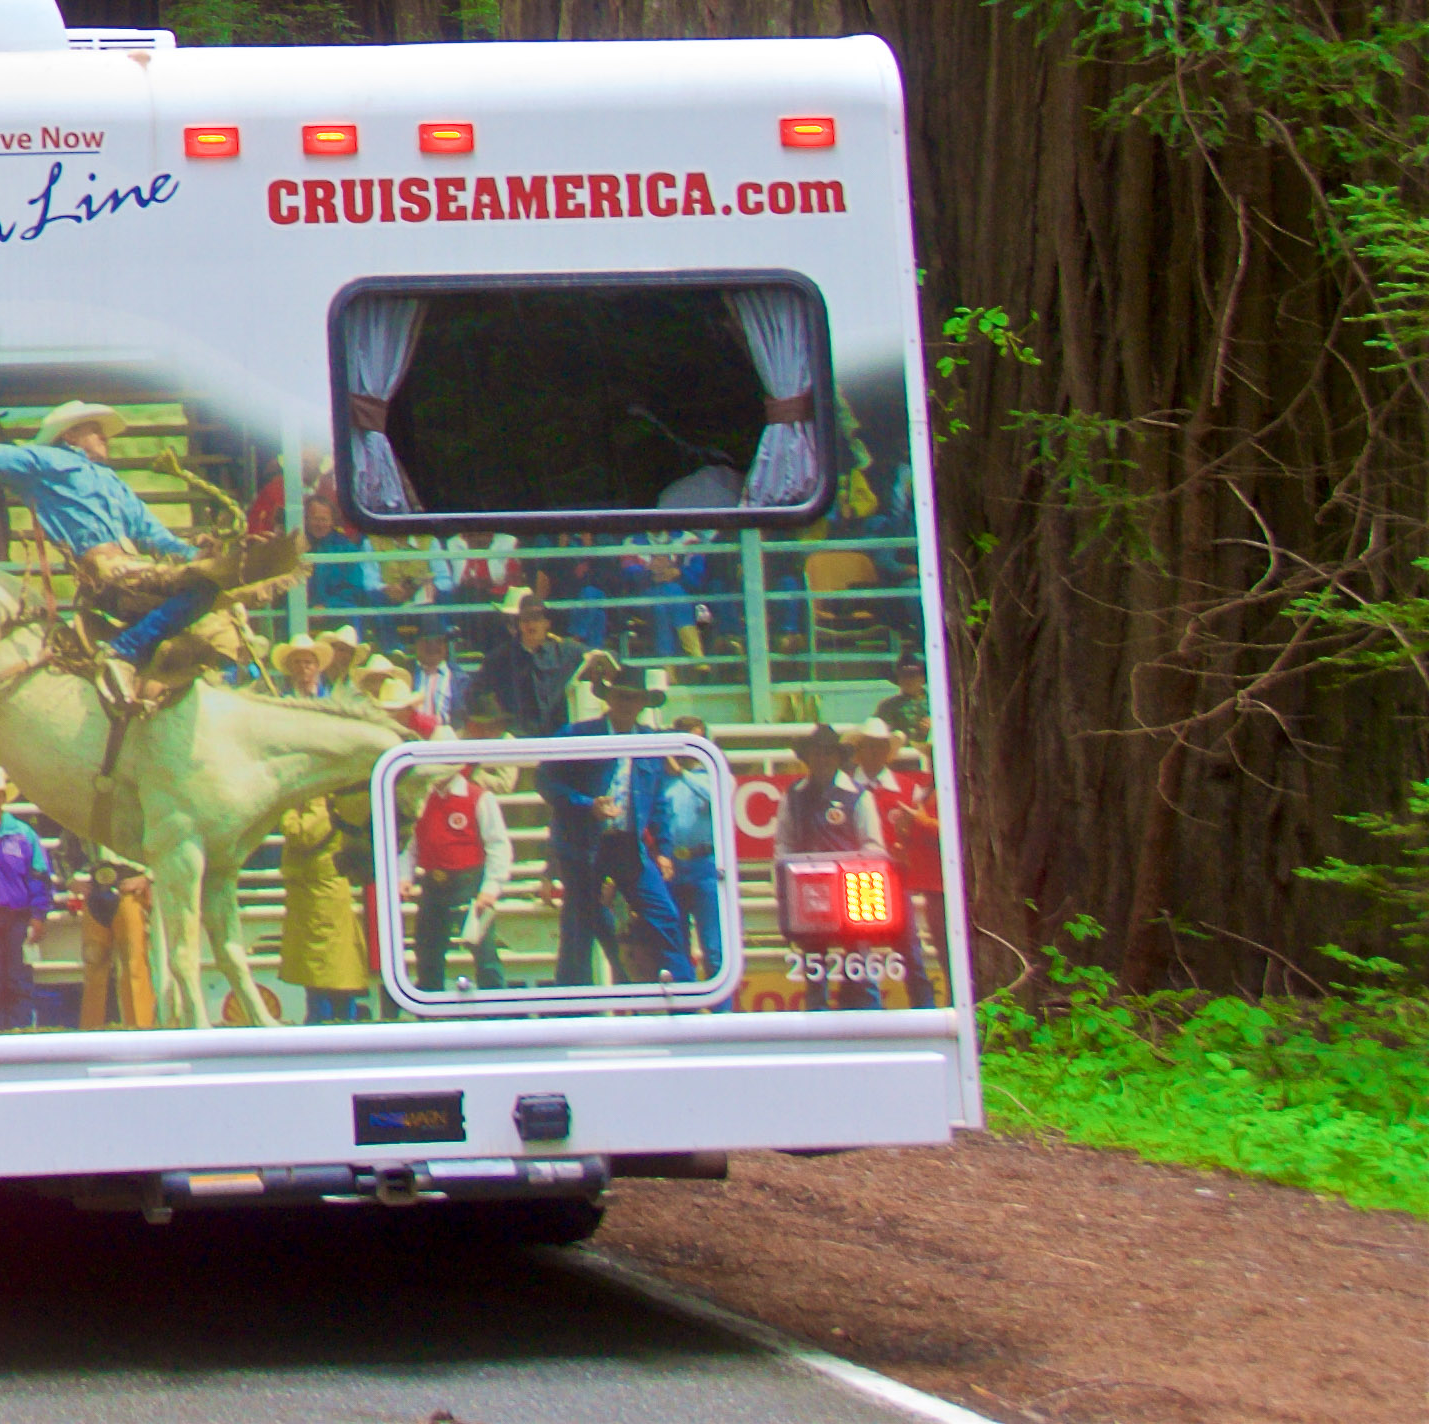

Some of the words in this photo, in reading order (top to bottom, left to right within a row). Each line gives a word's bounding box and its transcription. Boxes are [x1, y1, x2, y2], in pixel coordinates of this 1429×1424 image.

[40, 125, 105, 150] Now
[19, 161, 180, 241] Line
[267, 171, 848, 226] CRUISEAMERICA.com
[784, 951, 908, 983] 252666
